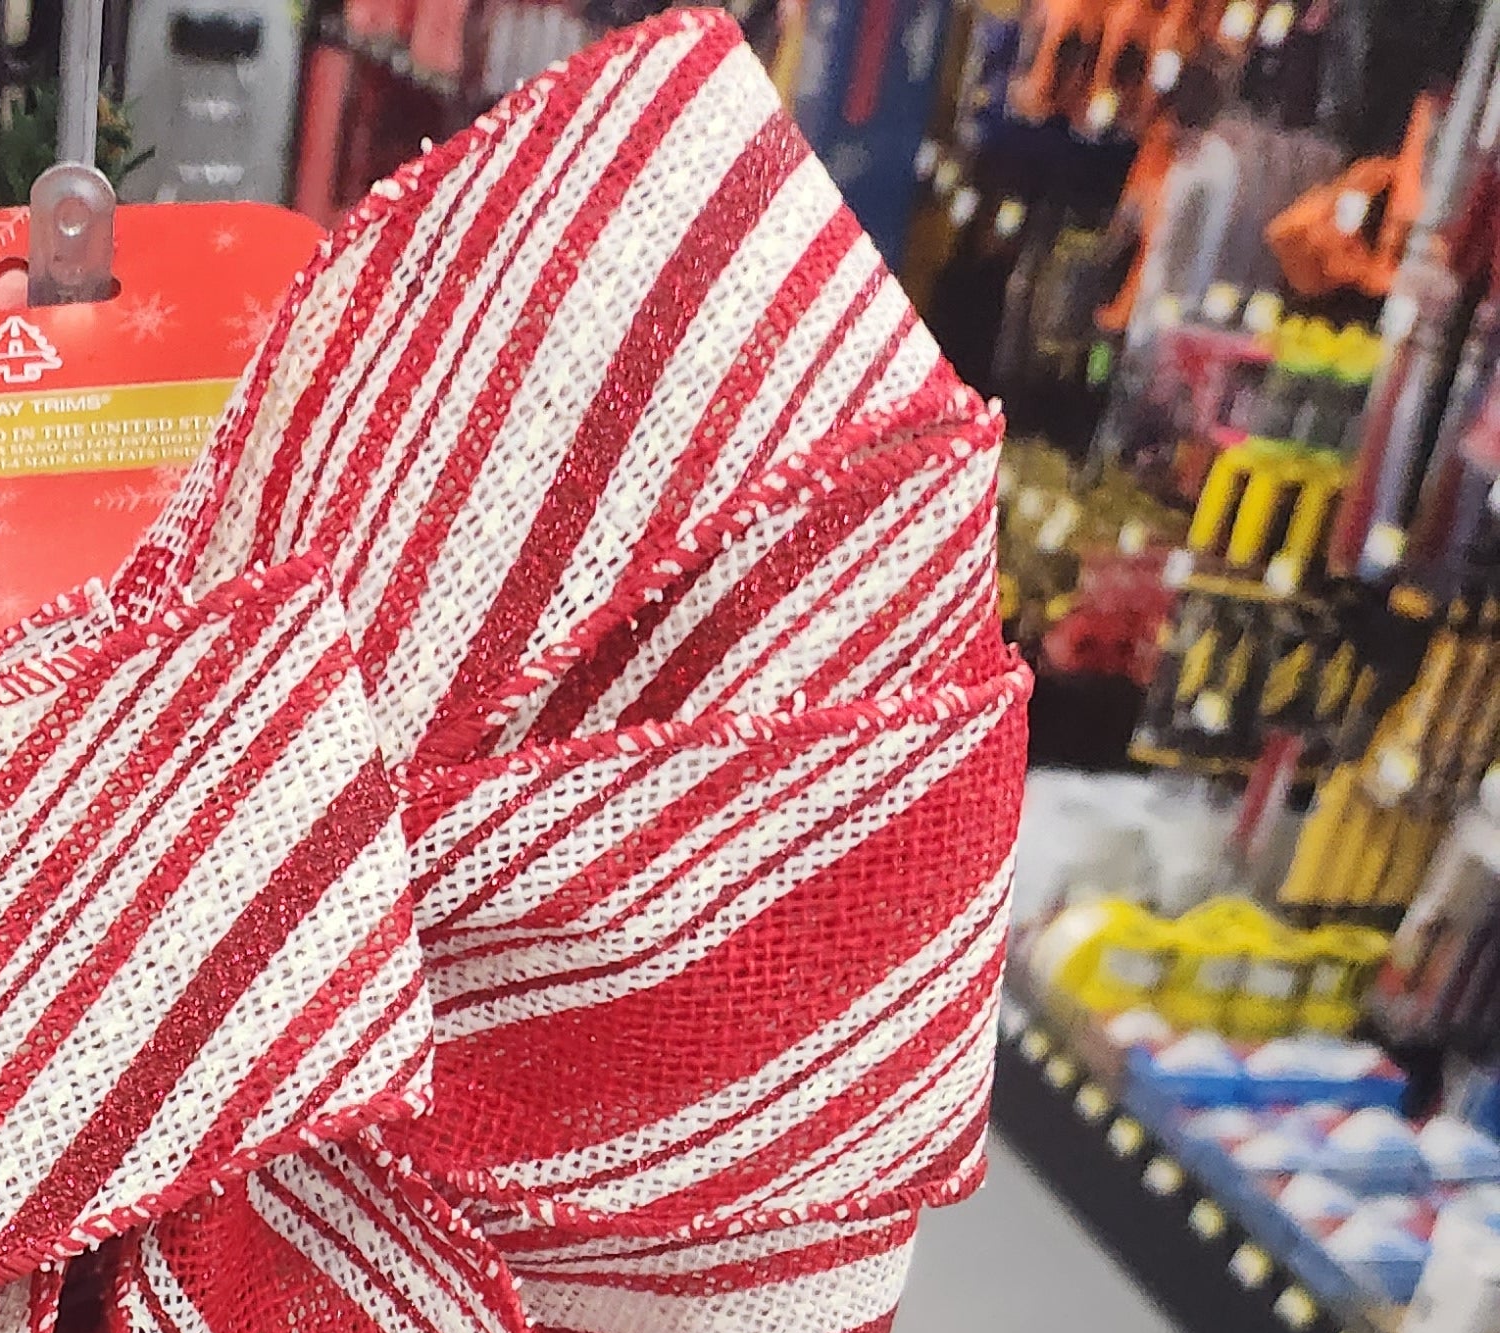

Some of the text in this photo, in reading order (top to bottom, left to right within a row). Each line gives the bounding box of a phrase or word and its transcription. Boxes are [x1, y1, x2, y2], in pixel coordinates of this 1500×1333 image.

[12, 426, 36, 442] IN
[42, 424, 85, 439] THE
[90, 418, 173, 435] UNITED
[179, 415, 216, 430] STA
